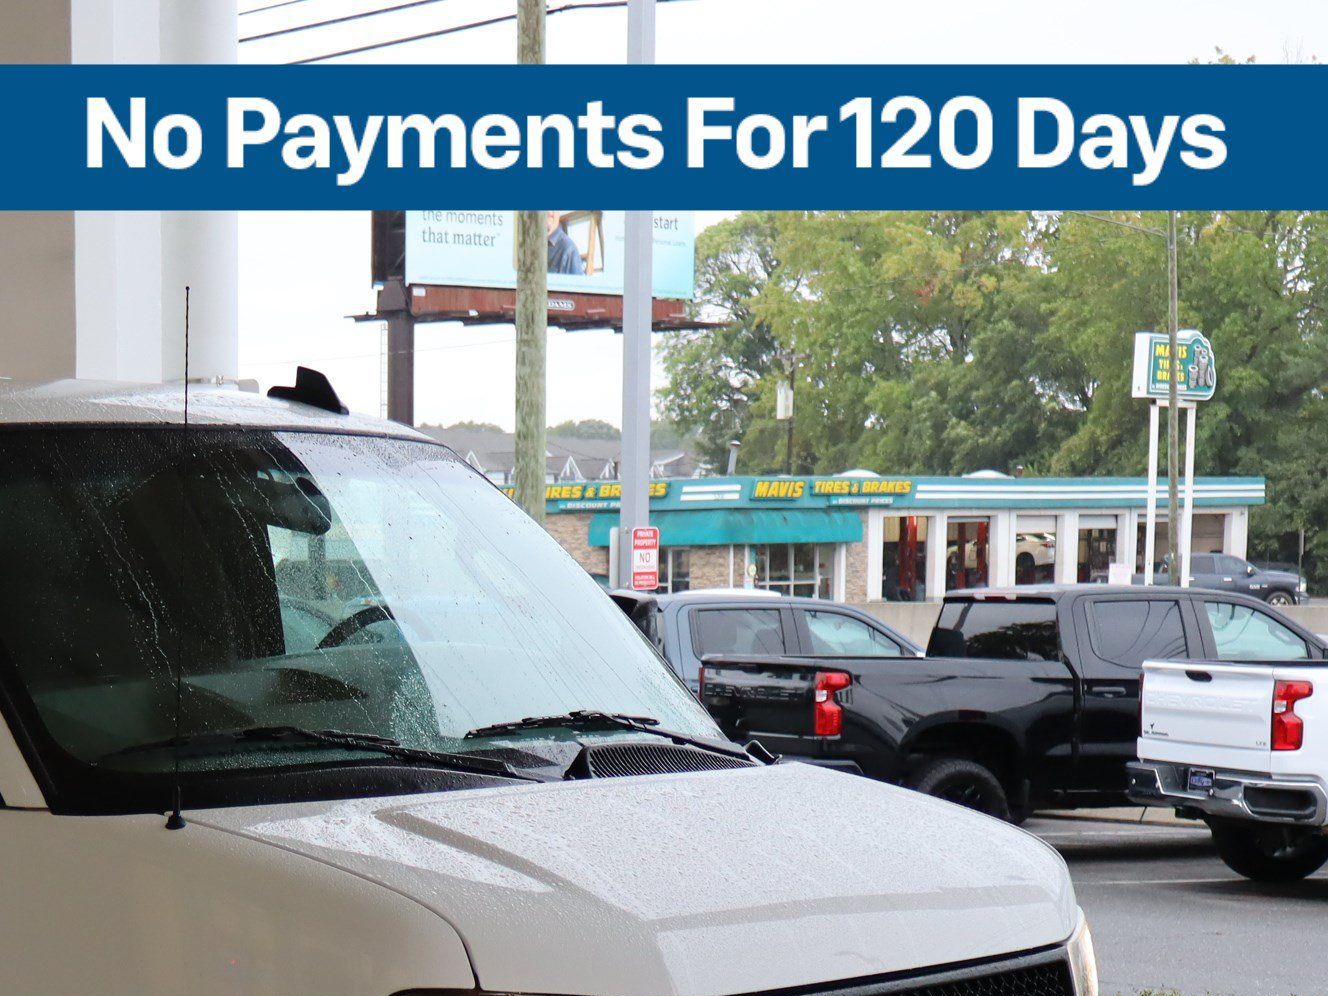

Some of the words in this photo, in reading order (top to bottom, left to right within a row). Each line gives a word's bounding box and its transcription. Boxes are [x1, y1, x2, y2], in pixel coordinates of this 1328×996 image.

[422, 211, 442, 222] the
[446, 211, 504, 226] moments
[653, 216, 678, 231] start
[422, 226, 450, 244] that
[453, 232, 496, 247] matter
[547, 300, 573, 309] DAMS
[1155, 344, 1188, 359] MAIS
[545, 485, 583, 499] IRES
[585, 486, 595, 498] &
[755, 481, 805, 498] MAVIS
[814, 481, 850, 494] TIRES
[852, 483, 859, 493] &
[862, 481, 912, 494] BRAKES
[639, 552, 651, 563] NO
